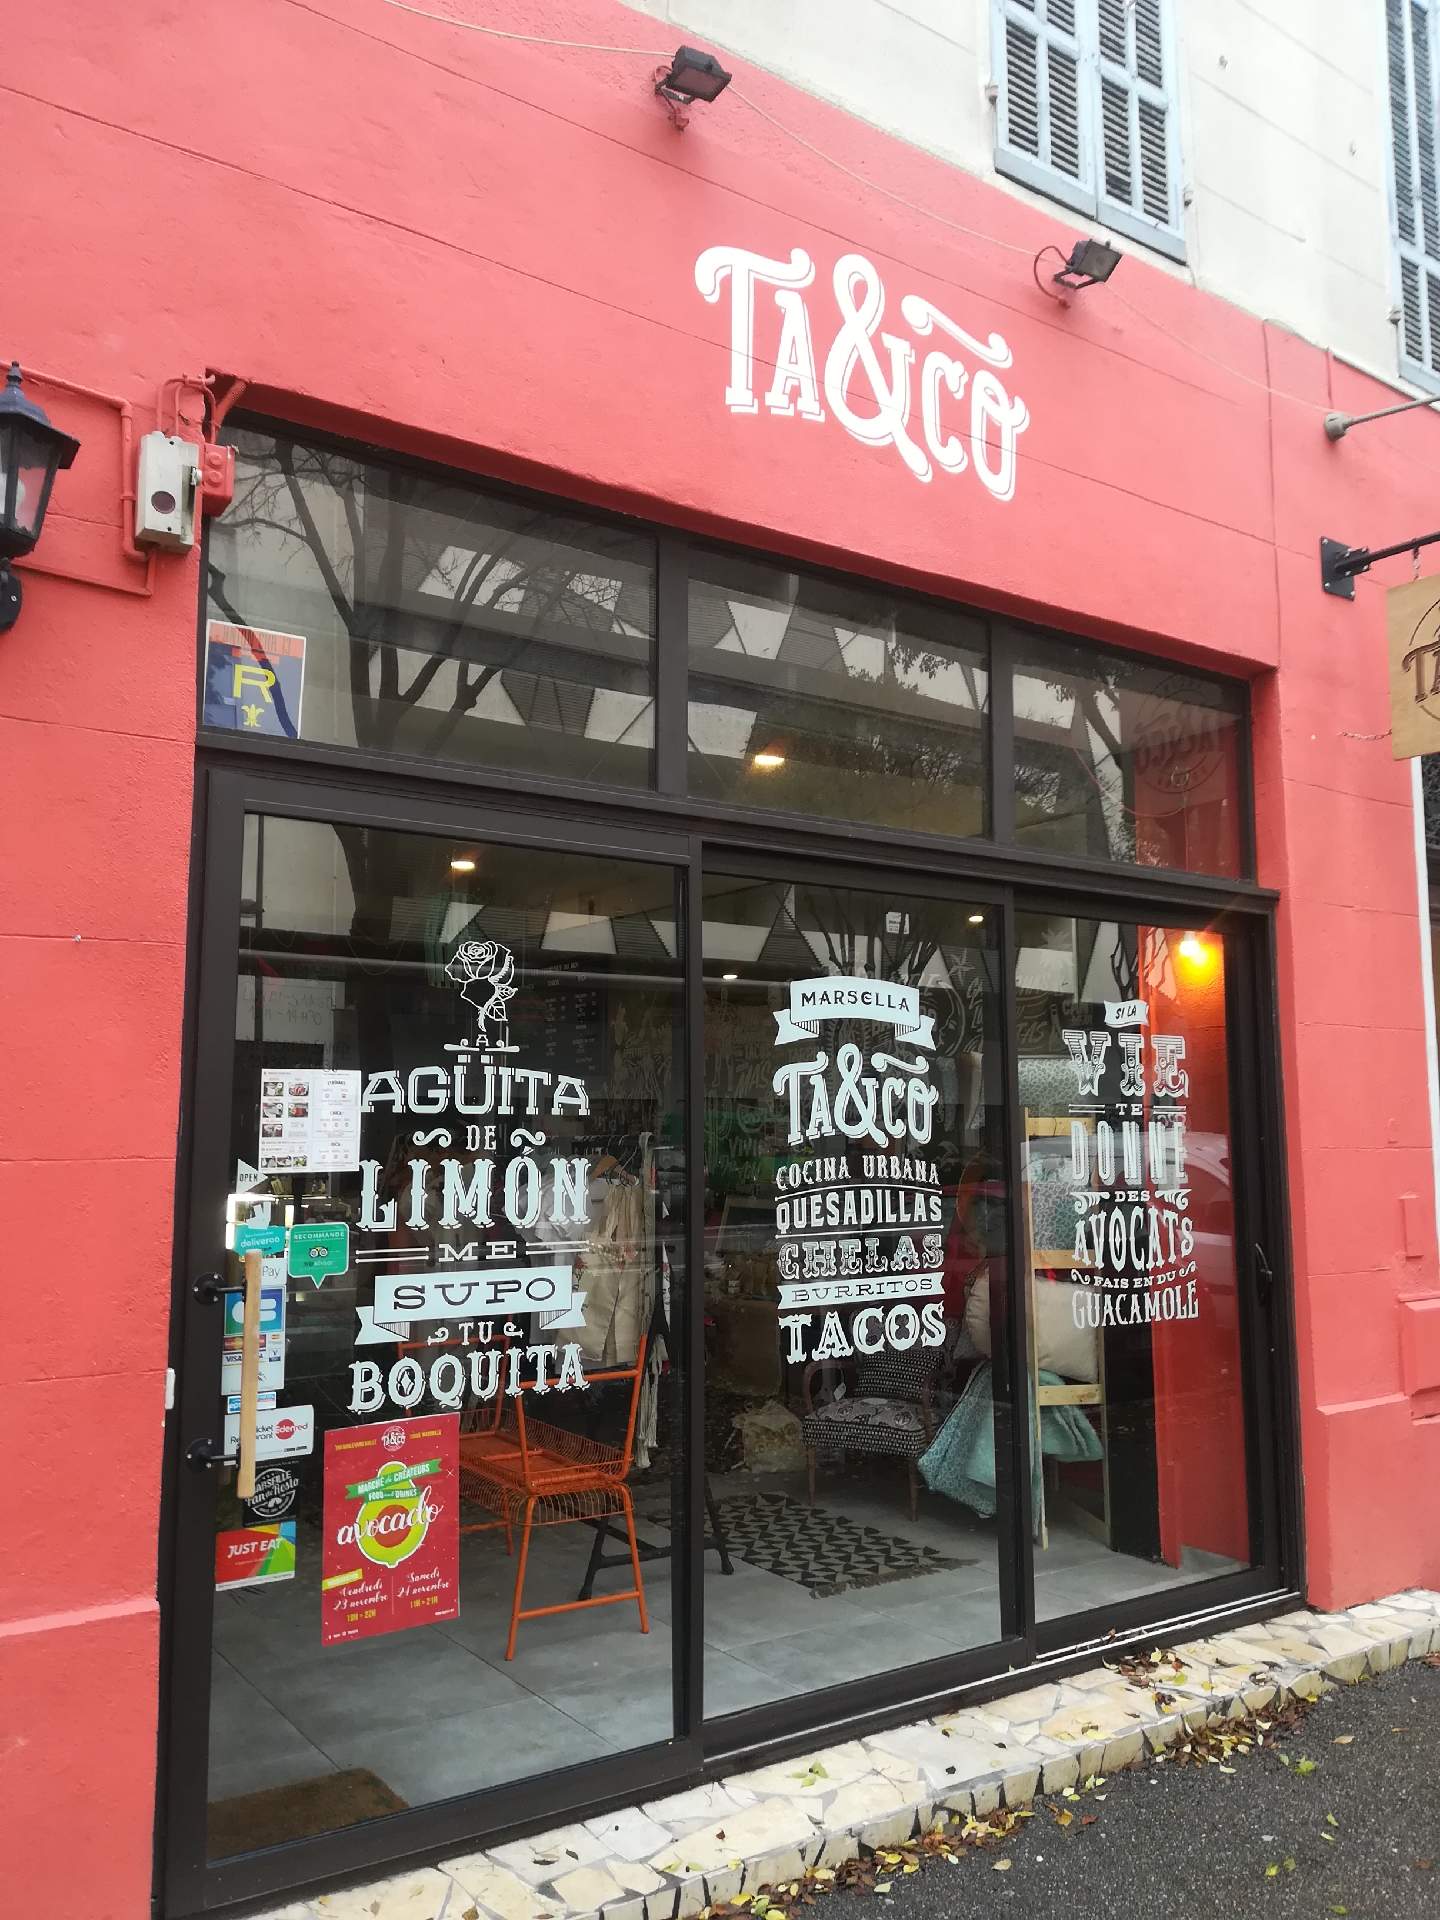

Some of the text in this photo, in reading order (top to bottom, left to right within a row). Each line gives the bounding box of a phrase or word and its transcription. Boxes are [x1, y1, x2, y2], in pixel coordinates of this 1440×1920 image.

[801, 990, 910, 1012] MARSELLA
[1115, 1005, 1137, 1020] SI LA
[1062, 1029, 1189, 1098] VIE
[360, 1055, 591, 1116] AGÜITA
[1115, 1103, 1144, 1116] TE
[466, 1125, 497, 1151] DE
[1070, 1120, 1188, 1186] DONNE
[240, 1173, 259, 1182] OPEN
[776, 1155, 940, 1190] COCINA URBANA
[355, 1146, 591, 1232] LIMÓN
[1114, 1190, 1150, 1202] DES
[776, 1189, 942, 1234] QUESADILLAS
[240, 1236, 280, 1248] deliveroo
[1072, 1205, 1195, 1272] AVOCATS
[438, 1241, 517, 1263] ME
[776, 1233, 945, 1280] CHELAS
[262, 1265, 280, 1278] Pay
[1093, 1270, 1176, 1289] FAIS EN DU
[393, 1277, 556, 1310] SUPO
[792, 1278, 933, 1302] BURRITOS
[1072, 1279, 1199, 1329] GUACAMOLE
[458, 1321, 495, 1346] TU
[778, 1301, 947, 1365] TACOS
[347, 1342, 591, 1415] BOQUITA
[255, 1422, 309, 1434] icket Edenred
[255, 1470, 292, 1492] ARSEILLE
[368, 1491, 384, 1501] FOOD
[395, 1488, 417, 1499] DRINKS
[336, 1485, 444, 1545] avocado
[227, 1538, 282, 1558] JUST EAT
[412, 1580, 449, 1595] novembre
[349, 1592, 388, 1608] novembre
